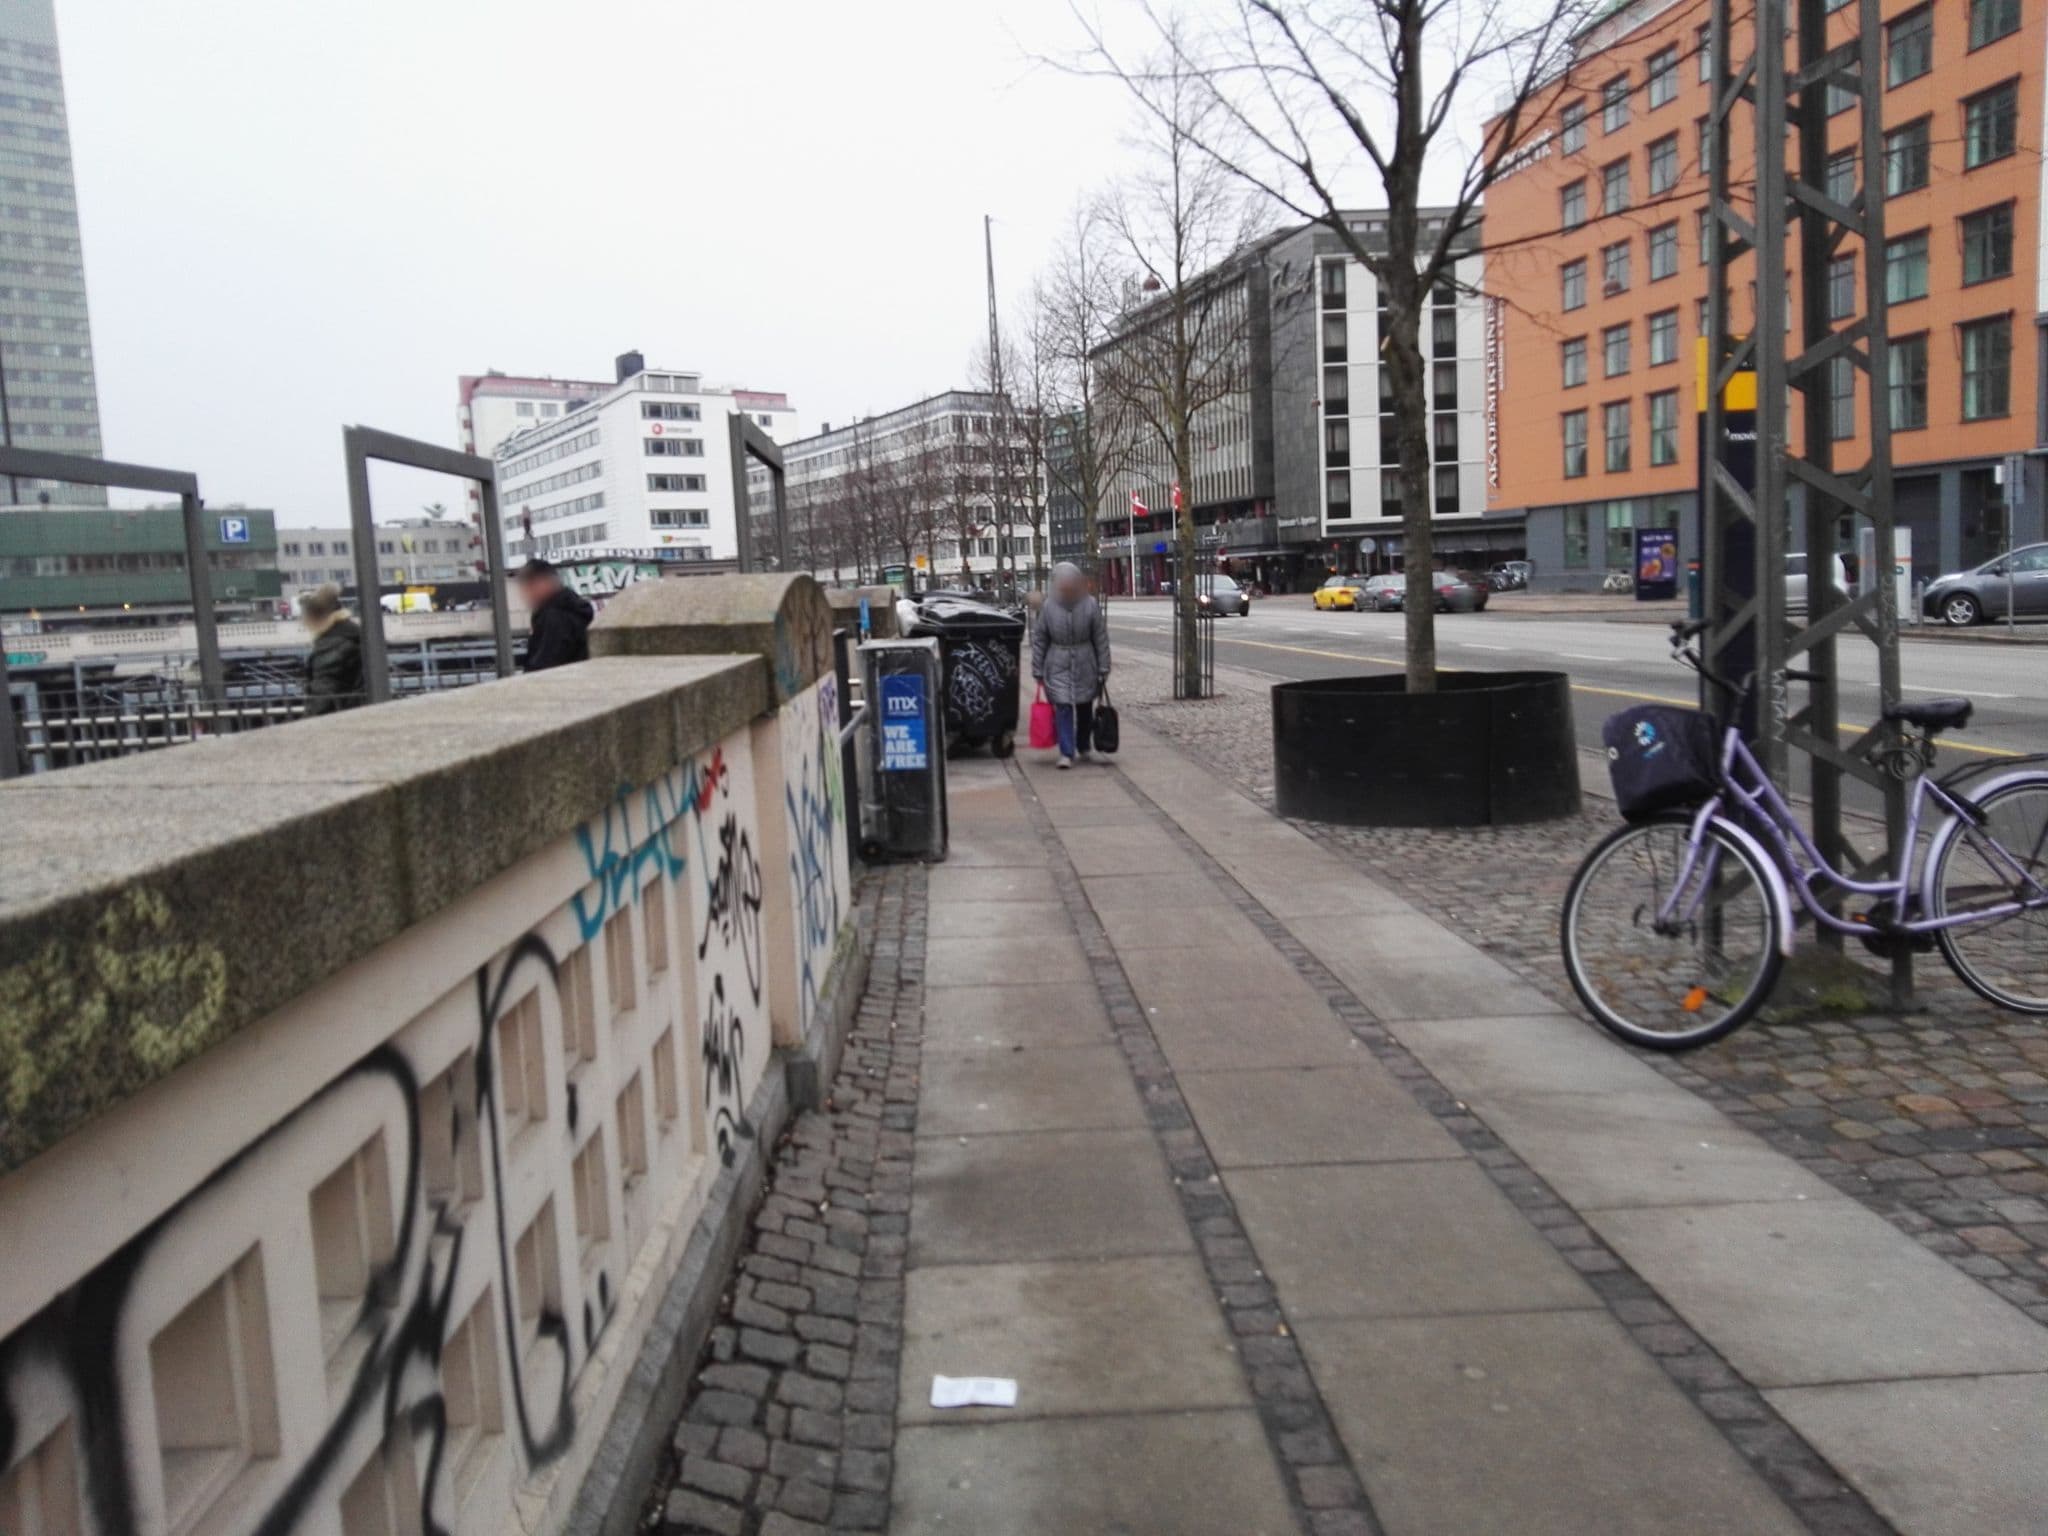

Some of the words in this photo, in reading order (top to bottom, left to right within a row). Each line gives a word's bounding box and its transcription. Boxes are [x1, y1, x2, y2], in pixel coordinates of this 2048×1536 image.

[1487, 296, 1500, 489] AKADEMIKERNES
[226, 519, 242, 539] P
[887, 695, 918, 711] mx
[883, 725, 909, 739] WE
[885, 739, 917, 753] ARE
[885, 753, 927, 769] FREE
